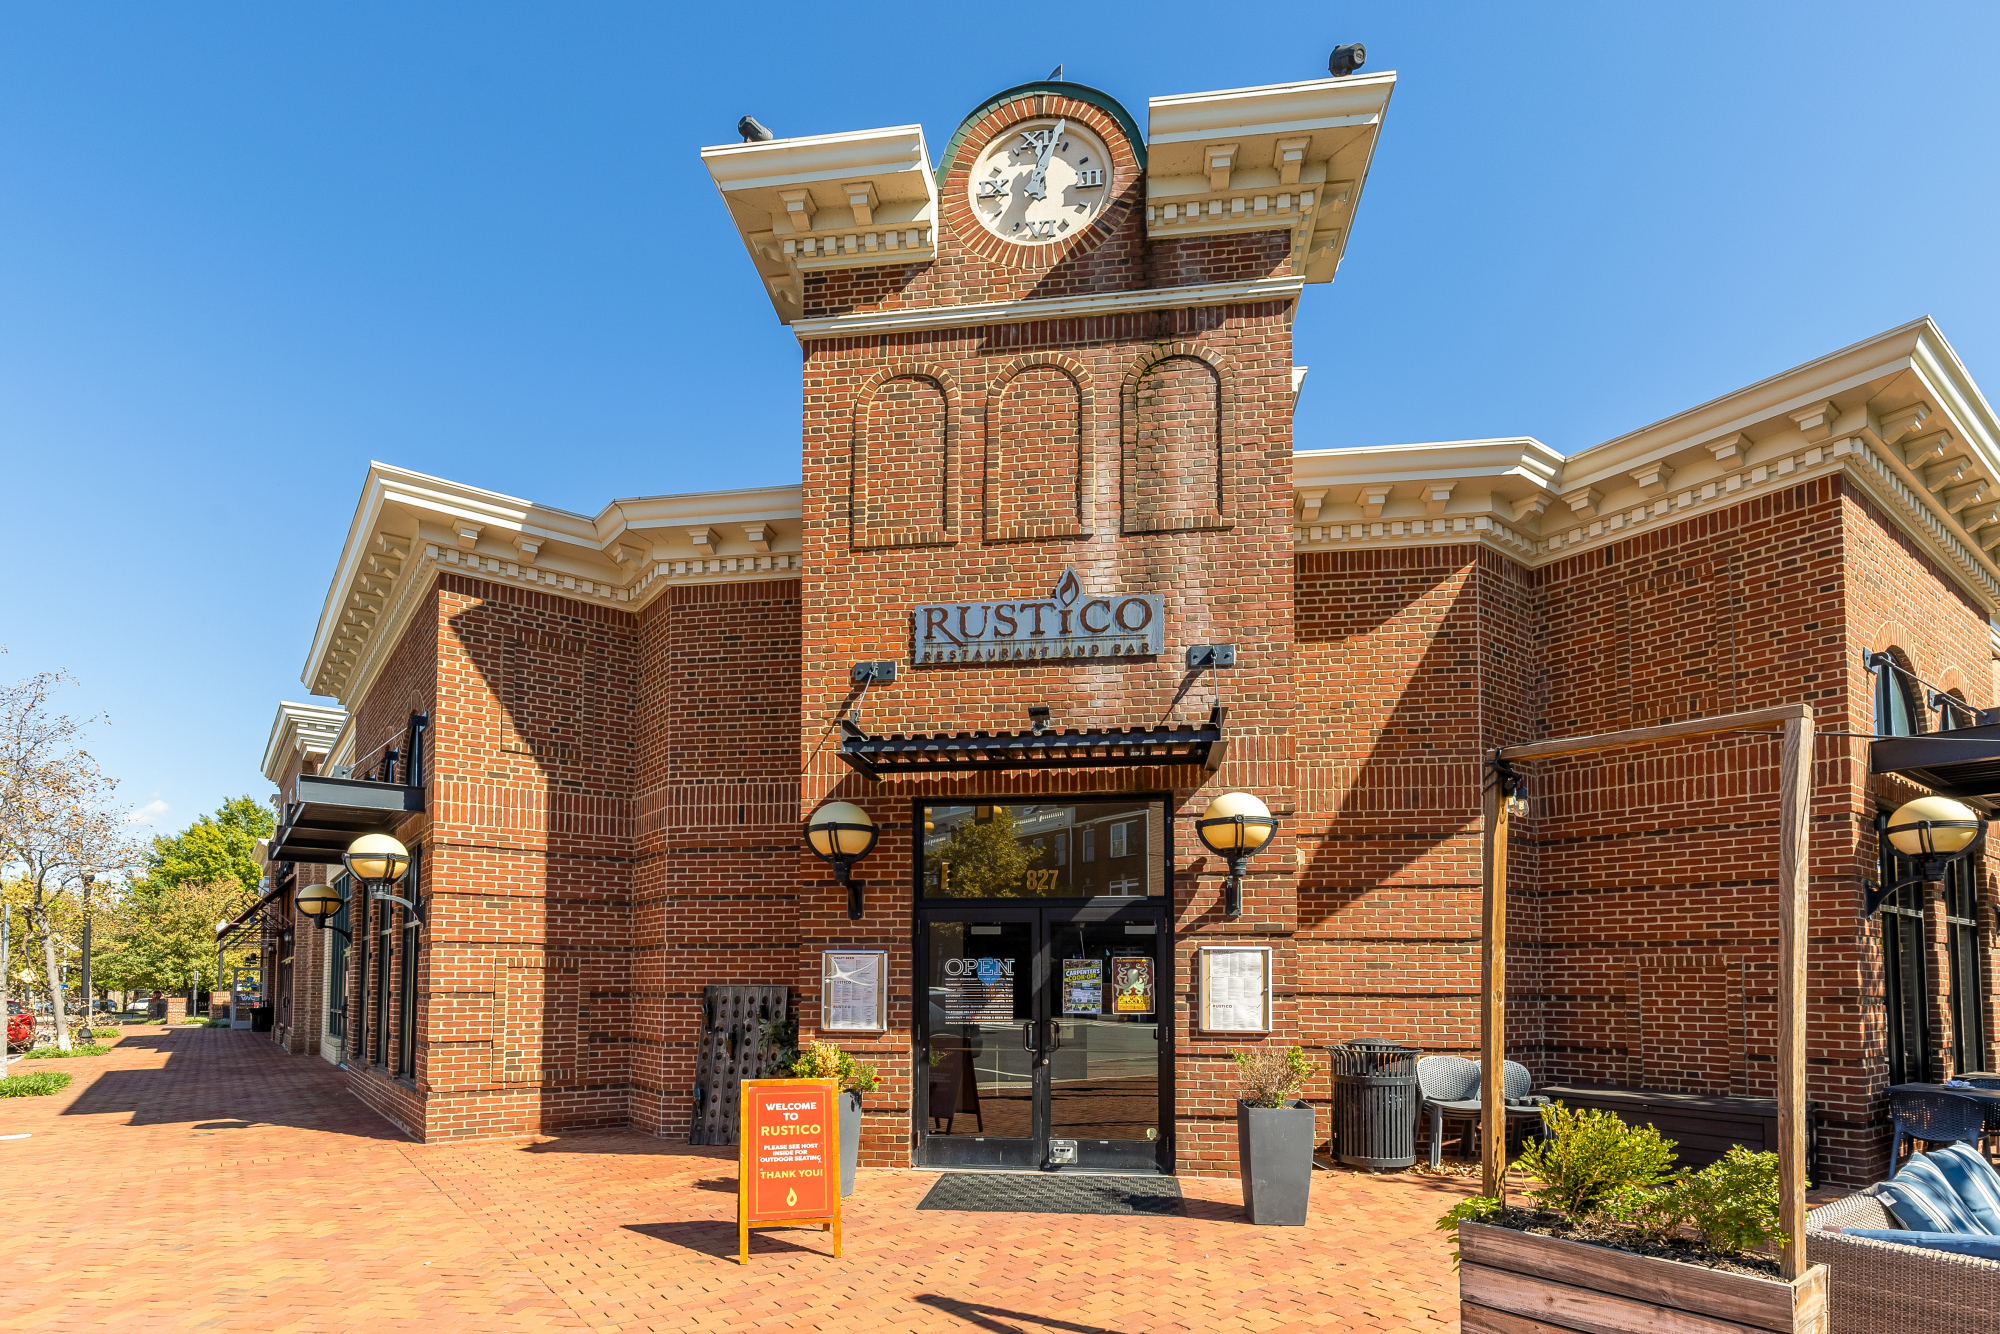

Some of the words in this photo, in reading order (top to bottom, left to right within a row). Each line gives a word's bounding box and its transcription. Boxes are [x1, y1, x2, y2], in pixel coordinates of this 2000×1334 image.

[1076, 169, 1102, 188] III
[979, 179, 1009, 198] IX
[1026, 220, 1056, 238] VI
[924, 646, 1050, 662] RESTAURANT
[1062, 644, 1100, 656] AND
[1112, 642, 1150, 654] BAR
[1026, 869, 1059, 890] 827
[944, 958, 1016, 976] OPEN
[765, 1102, 817, 1111] WELCOME
[783, 1112, 799, 1121] TO
[760, 1124, 821, 1136] RUSTICO
[760, 1170, 796, 1179] THANK
[799, 1169, 823, 1177] YOU!
